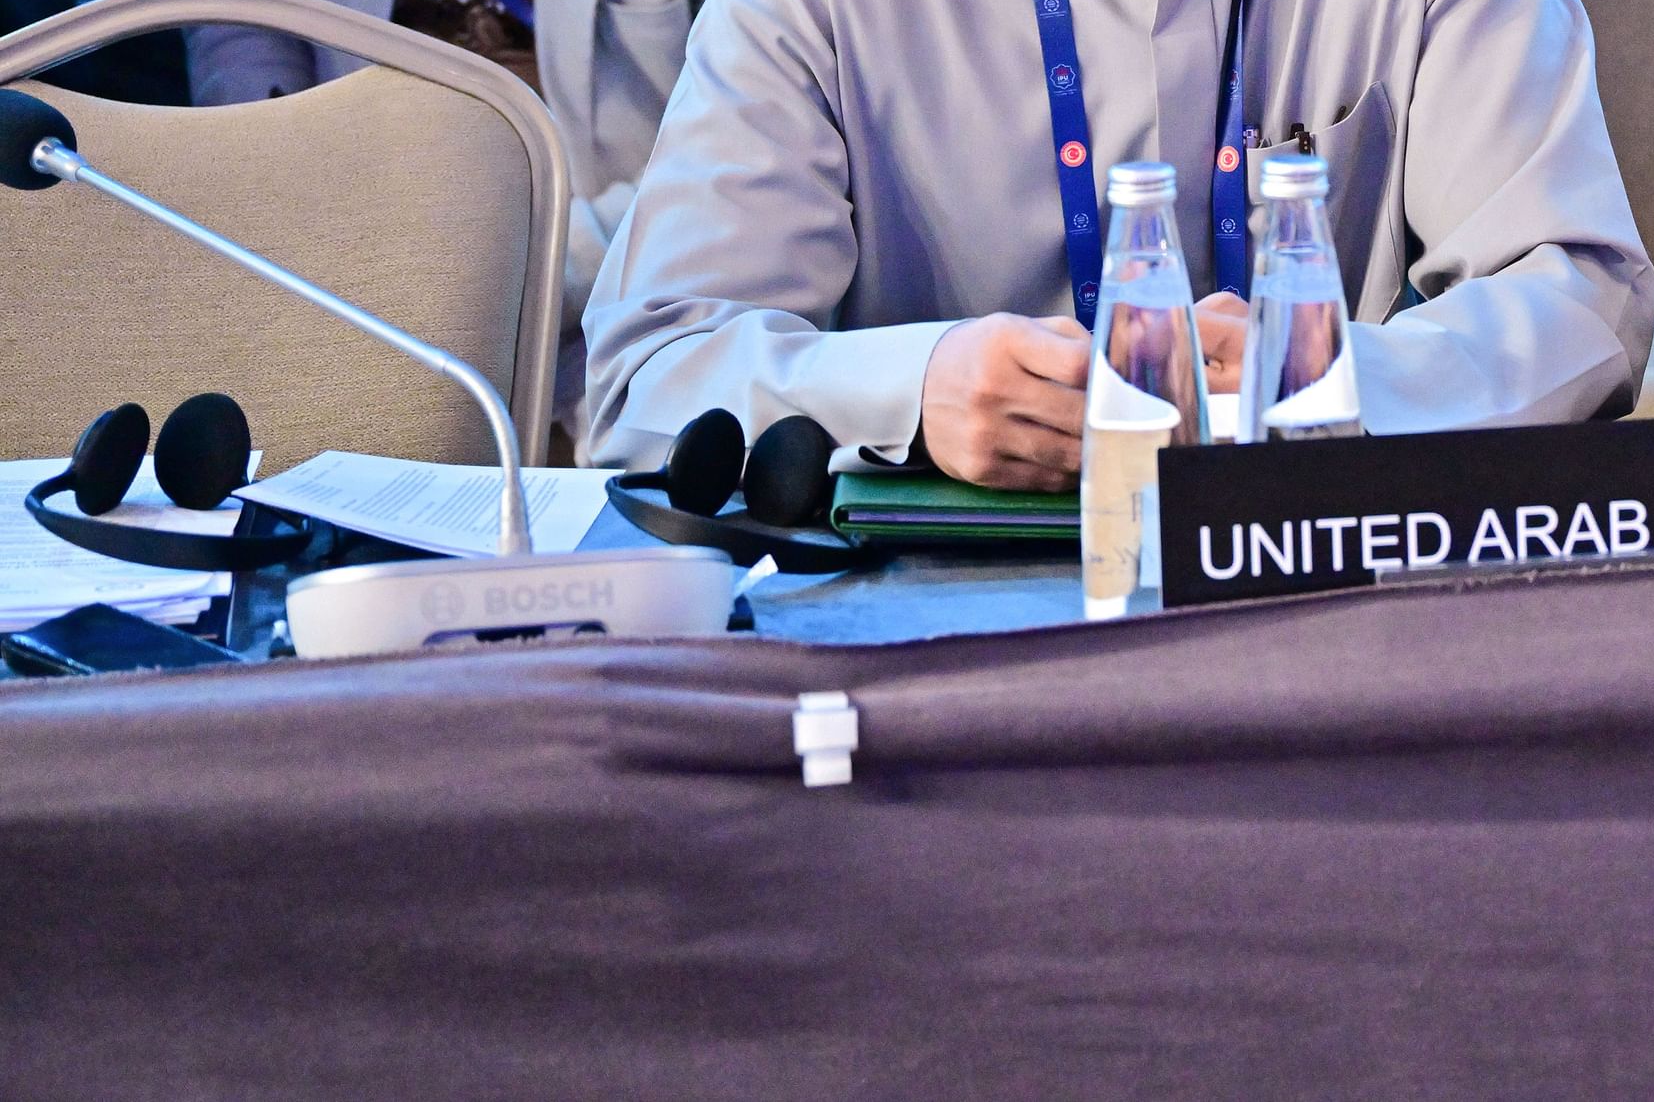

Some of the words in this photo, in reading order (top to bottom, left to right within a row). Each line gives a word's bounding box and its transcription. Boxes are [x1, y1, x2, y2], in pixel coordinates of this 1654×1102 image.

[1199, 512, 1452, 580] UNITED
[1467, 499, 1650, 566] ARAB
[484, 577, 614, 615] BOSCH
